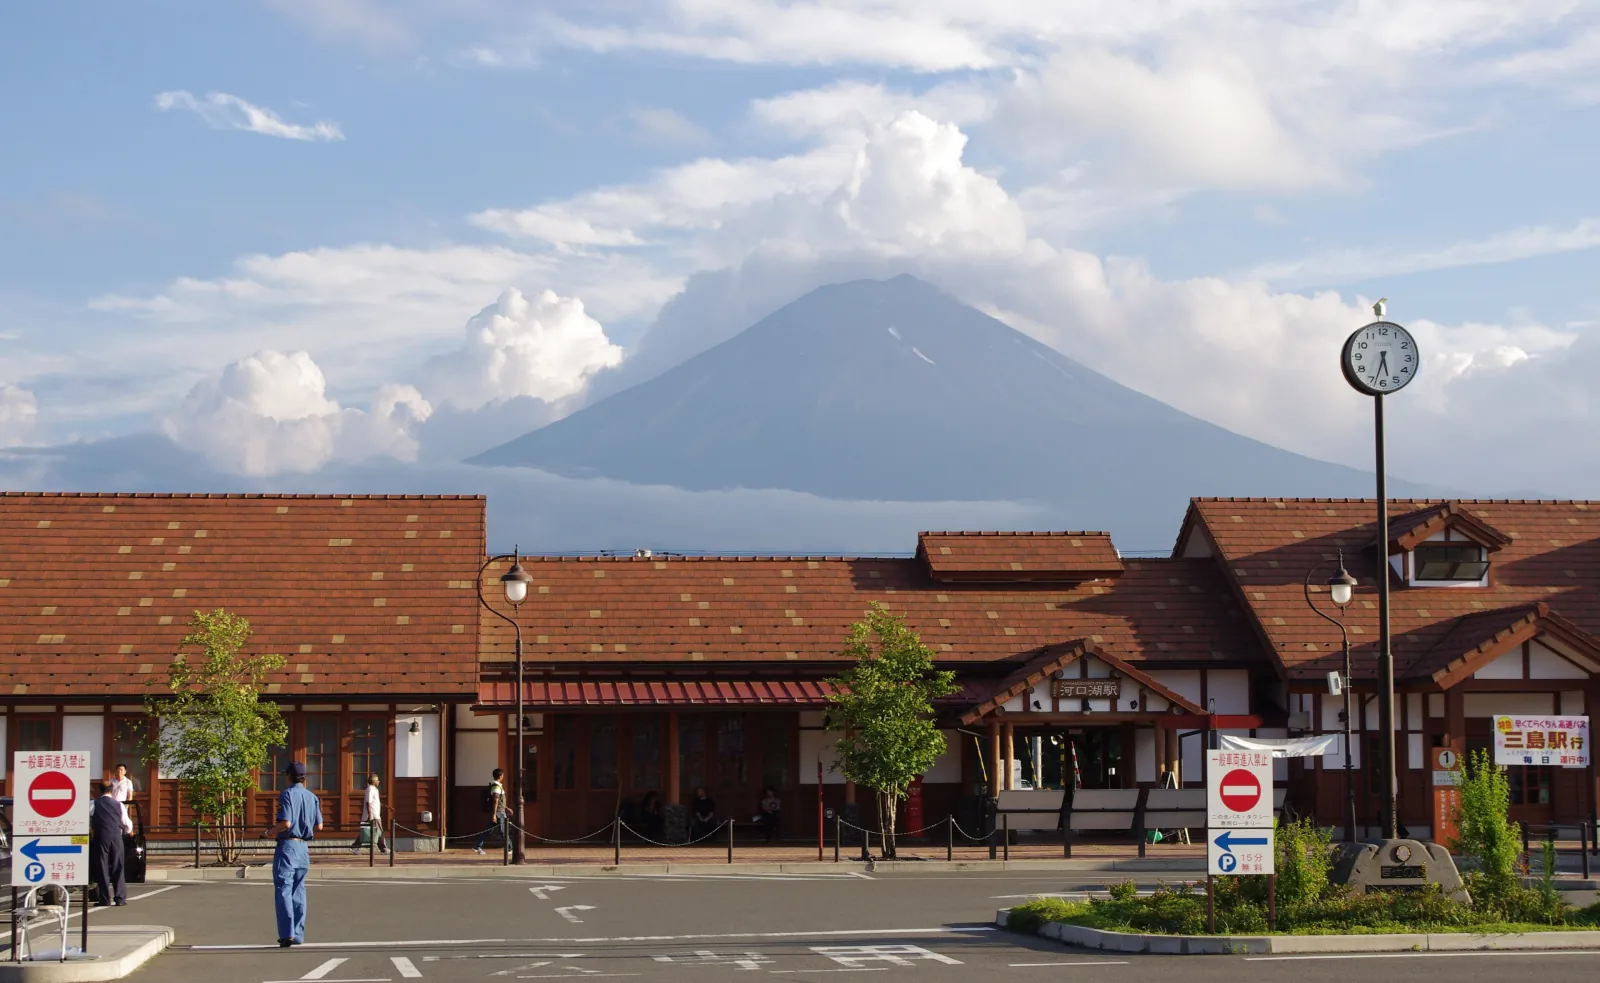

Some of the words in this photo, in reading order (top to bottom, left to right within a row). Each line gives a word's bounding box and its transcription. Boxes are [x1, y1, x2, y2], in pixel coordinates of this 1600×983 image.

[1366, 332, 1375, 340] 11
[1378, 328, 1388, 336] 12
[1401, 341, 1408, 349] 2
[1358, 365, 1366, 373] 8
[1400, 366, 1408, 374] 4
[1392, 376, 1400, 384] 5
[1060, 685, 1118, 697] 河口湖駅
[20, 754, 86, 769] 一般車両進入禁止
[1212, 753, 1268, 767] 一般車両進入禁止
[1443, 751, 1449, 764] 1
[1222, 855, 1234, 870] P
[29, 864, 42, 880] P
